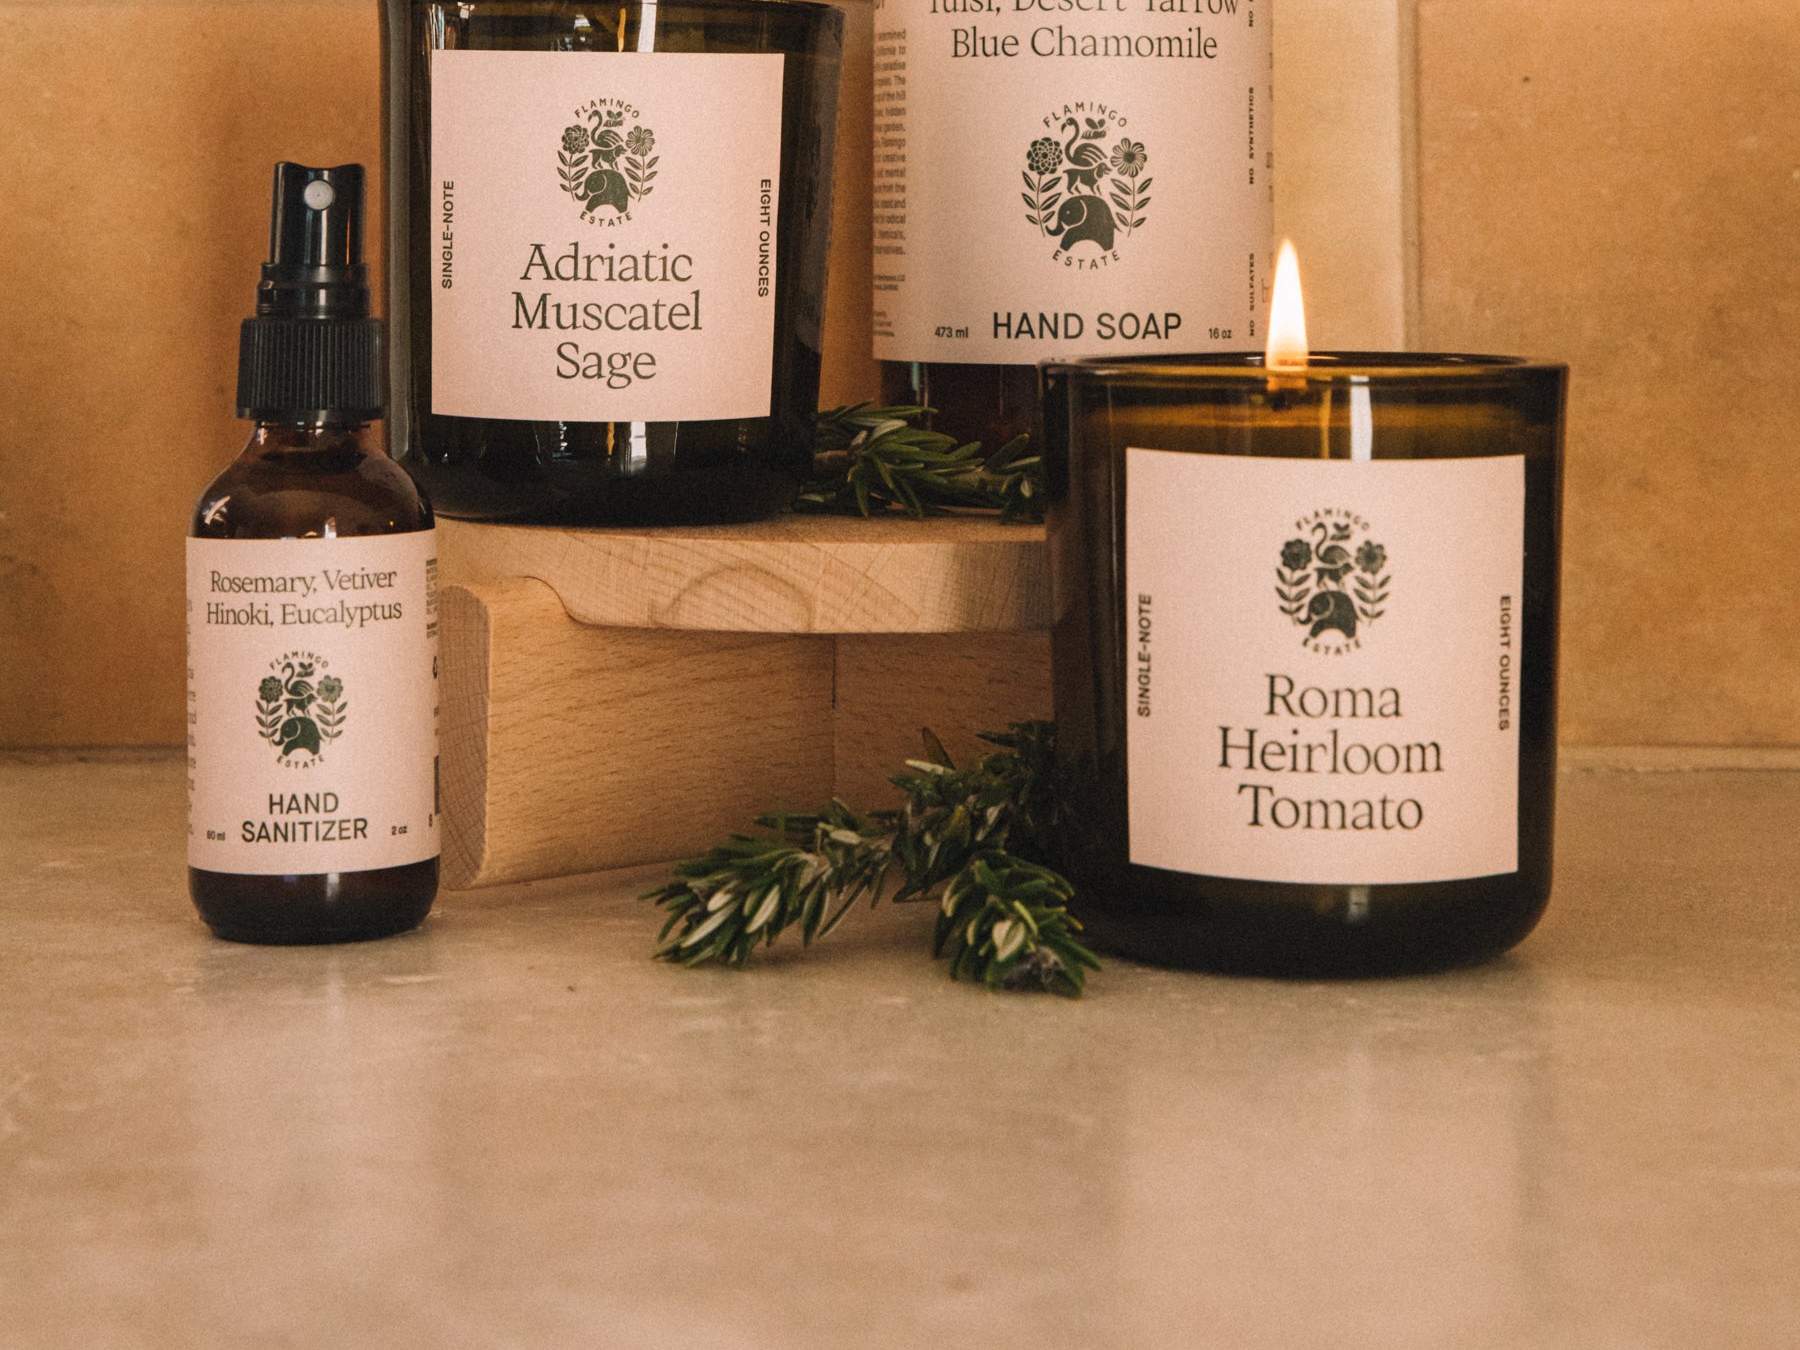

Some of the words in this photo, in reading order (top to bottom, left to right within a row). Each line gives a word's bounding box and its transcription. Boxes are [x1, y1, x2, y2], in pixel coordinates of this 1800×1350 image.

[1248, 10, 1254, 28] NO
[952, 27, 1018, 57] Blue
[1031, 26, 1217, 59] Chamomile
[575, 98, 640, 121] FLAMINGO
[1043, 101, 1127, 131] FLAMINGO
[1248, 167, 1255, 185] NO
[760, 178, 772, 227] EIGHT
[442, 180, 454, 290] SINGLE-NOTE
[580, 212, 632, 228] ESTATE
[520, 242, 692, 282] Adriatic
[758, 230, 770, 298] OUNCES
[1052, 251, 1120, 270] ESTATE
[512, 290, 702, 330] Muscatel
[935, 326, 953, 339] 473
[956, 326, 969, 339] ml
[994, 312, 1083, 339] HAND
[1097, 313, 1181, 339] SOAP
[1209, 327, 1220, 340] 16
[1222, 329, 1232, 339] oz
[1249, 319, 1255, 337] NO
[557, 342, 656, 389] Sage
[1295, 507, 1370, 531] FLAMINGO
[210, 571, 316, 597] Rosemary,
[323, 567, 397, 590] Vetiver
[207, 602, 273, 626] Hinoki,
[281, 600, 402, 628] Eucalyptus
[1500, 595, 1512, 648] EIGHT
[269, 650, 330, 670] FLAMINGO
[1138, 594, 1152, 718] SINGLE-NOTE
[1302, 638, 1361, 656] ESTATE
[1266, 674, 1401, 718] Roma
[1499, 654, 1511, 731] OUNCES
[277, 755, 325, 769] ESTATE
[1219, 726, 1443, 774] Heirloom
[269, 793, 338, 814] HAND
[1238, 784, 1423, 830] Tomato
[242, 818, 367, 843] SANITIZER
